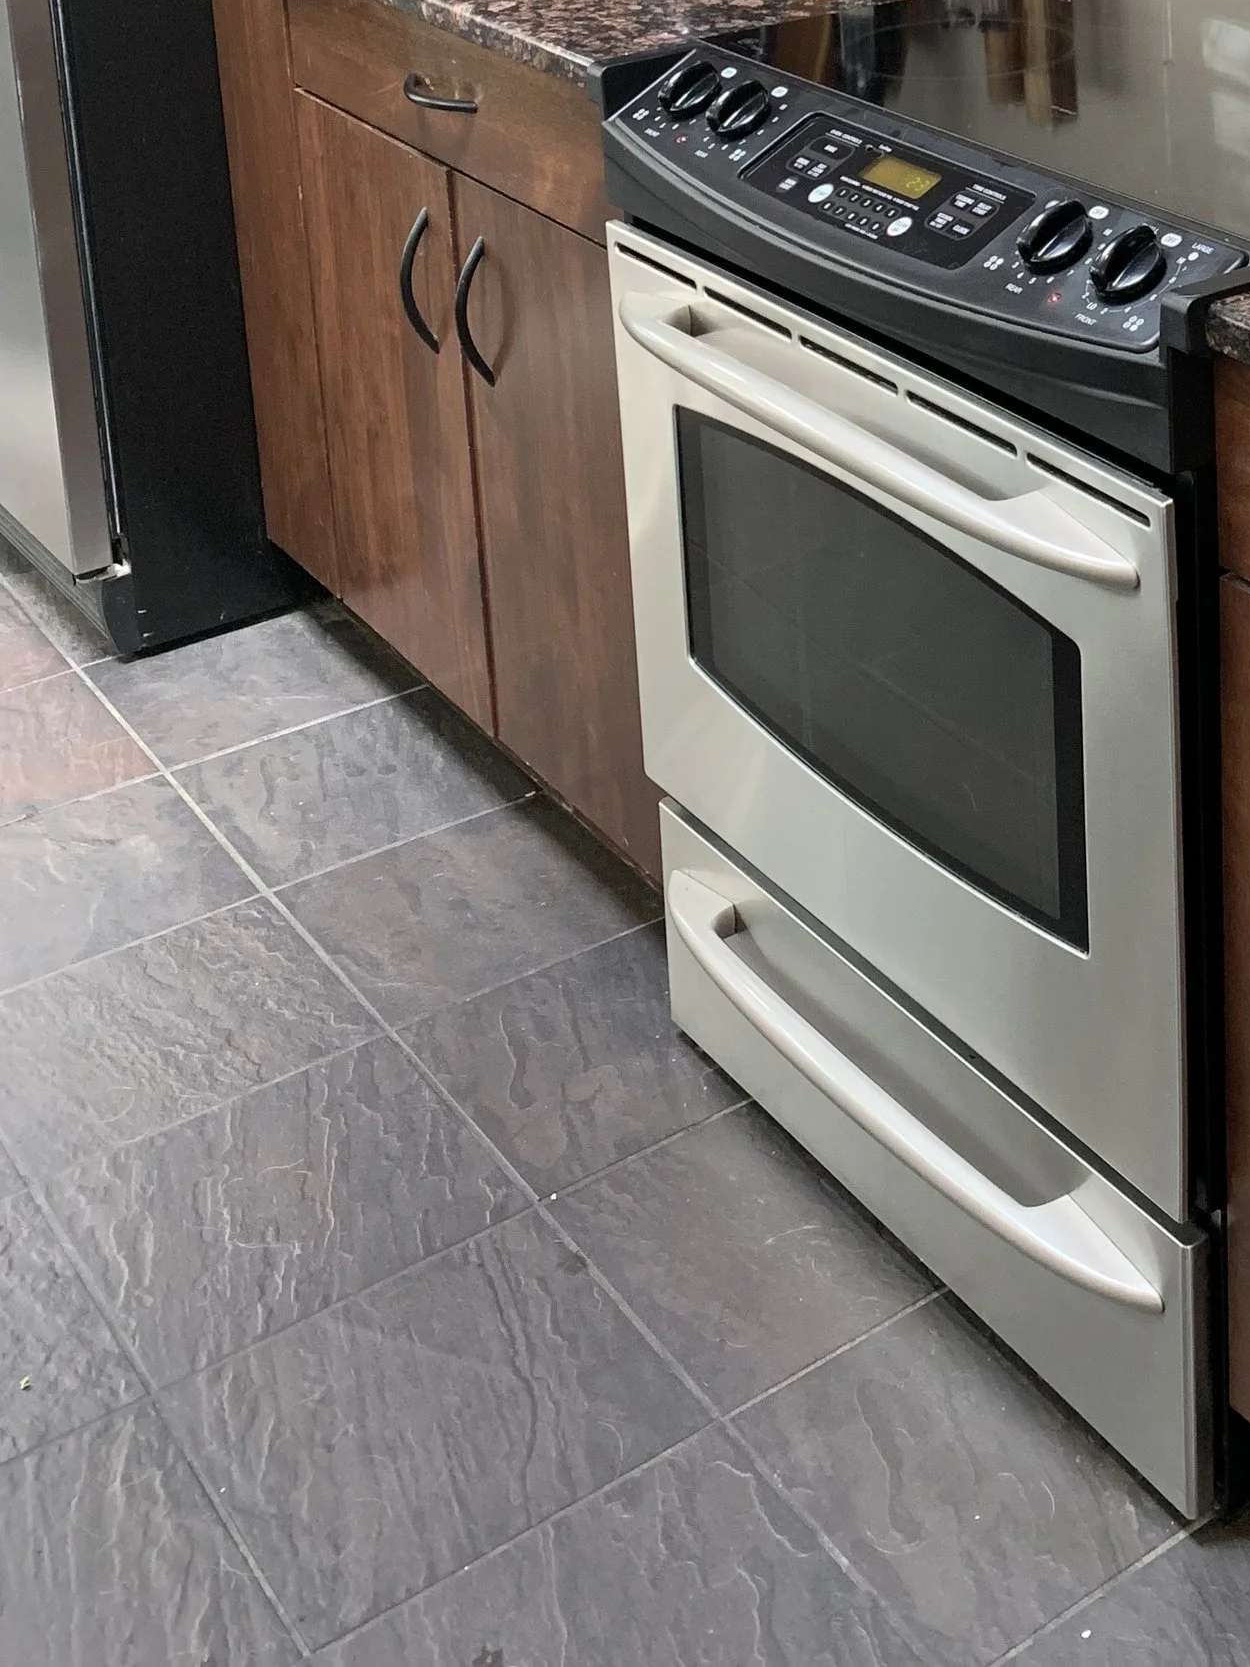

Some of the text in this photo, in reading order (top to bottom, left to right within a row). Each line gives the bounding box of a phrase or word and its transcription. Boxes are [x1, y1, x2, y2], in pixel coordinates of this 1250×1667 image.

[1164, 236, 1179, 244] OFF
[1191, 242, 1214, 255] LARGE
[1005, 283, 1023, 294] REAR
[1086, 302, 1097, 311] LO
[1074, 313, 1097, 326] FRONT
